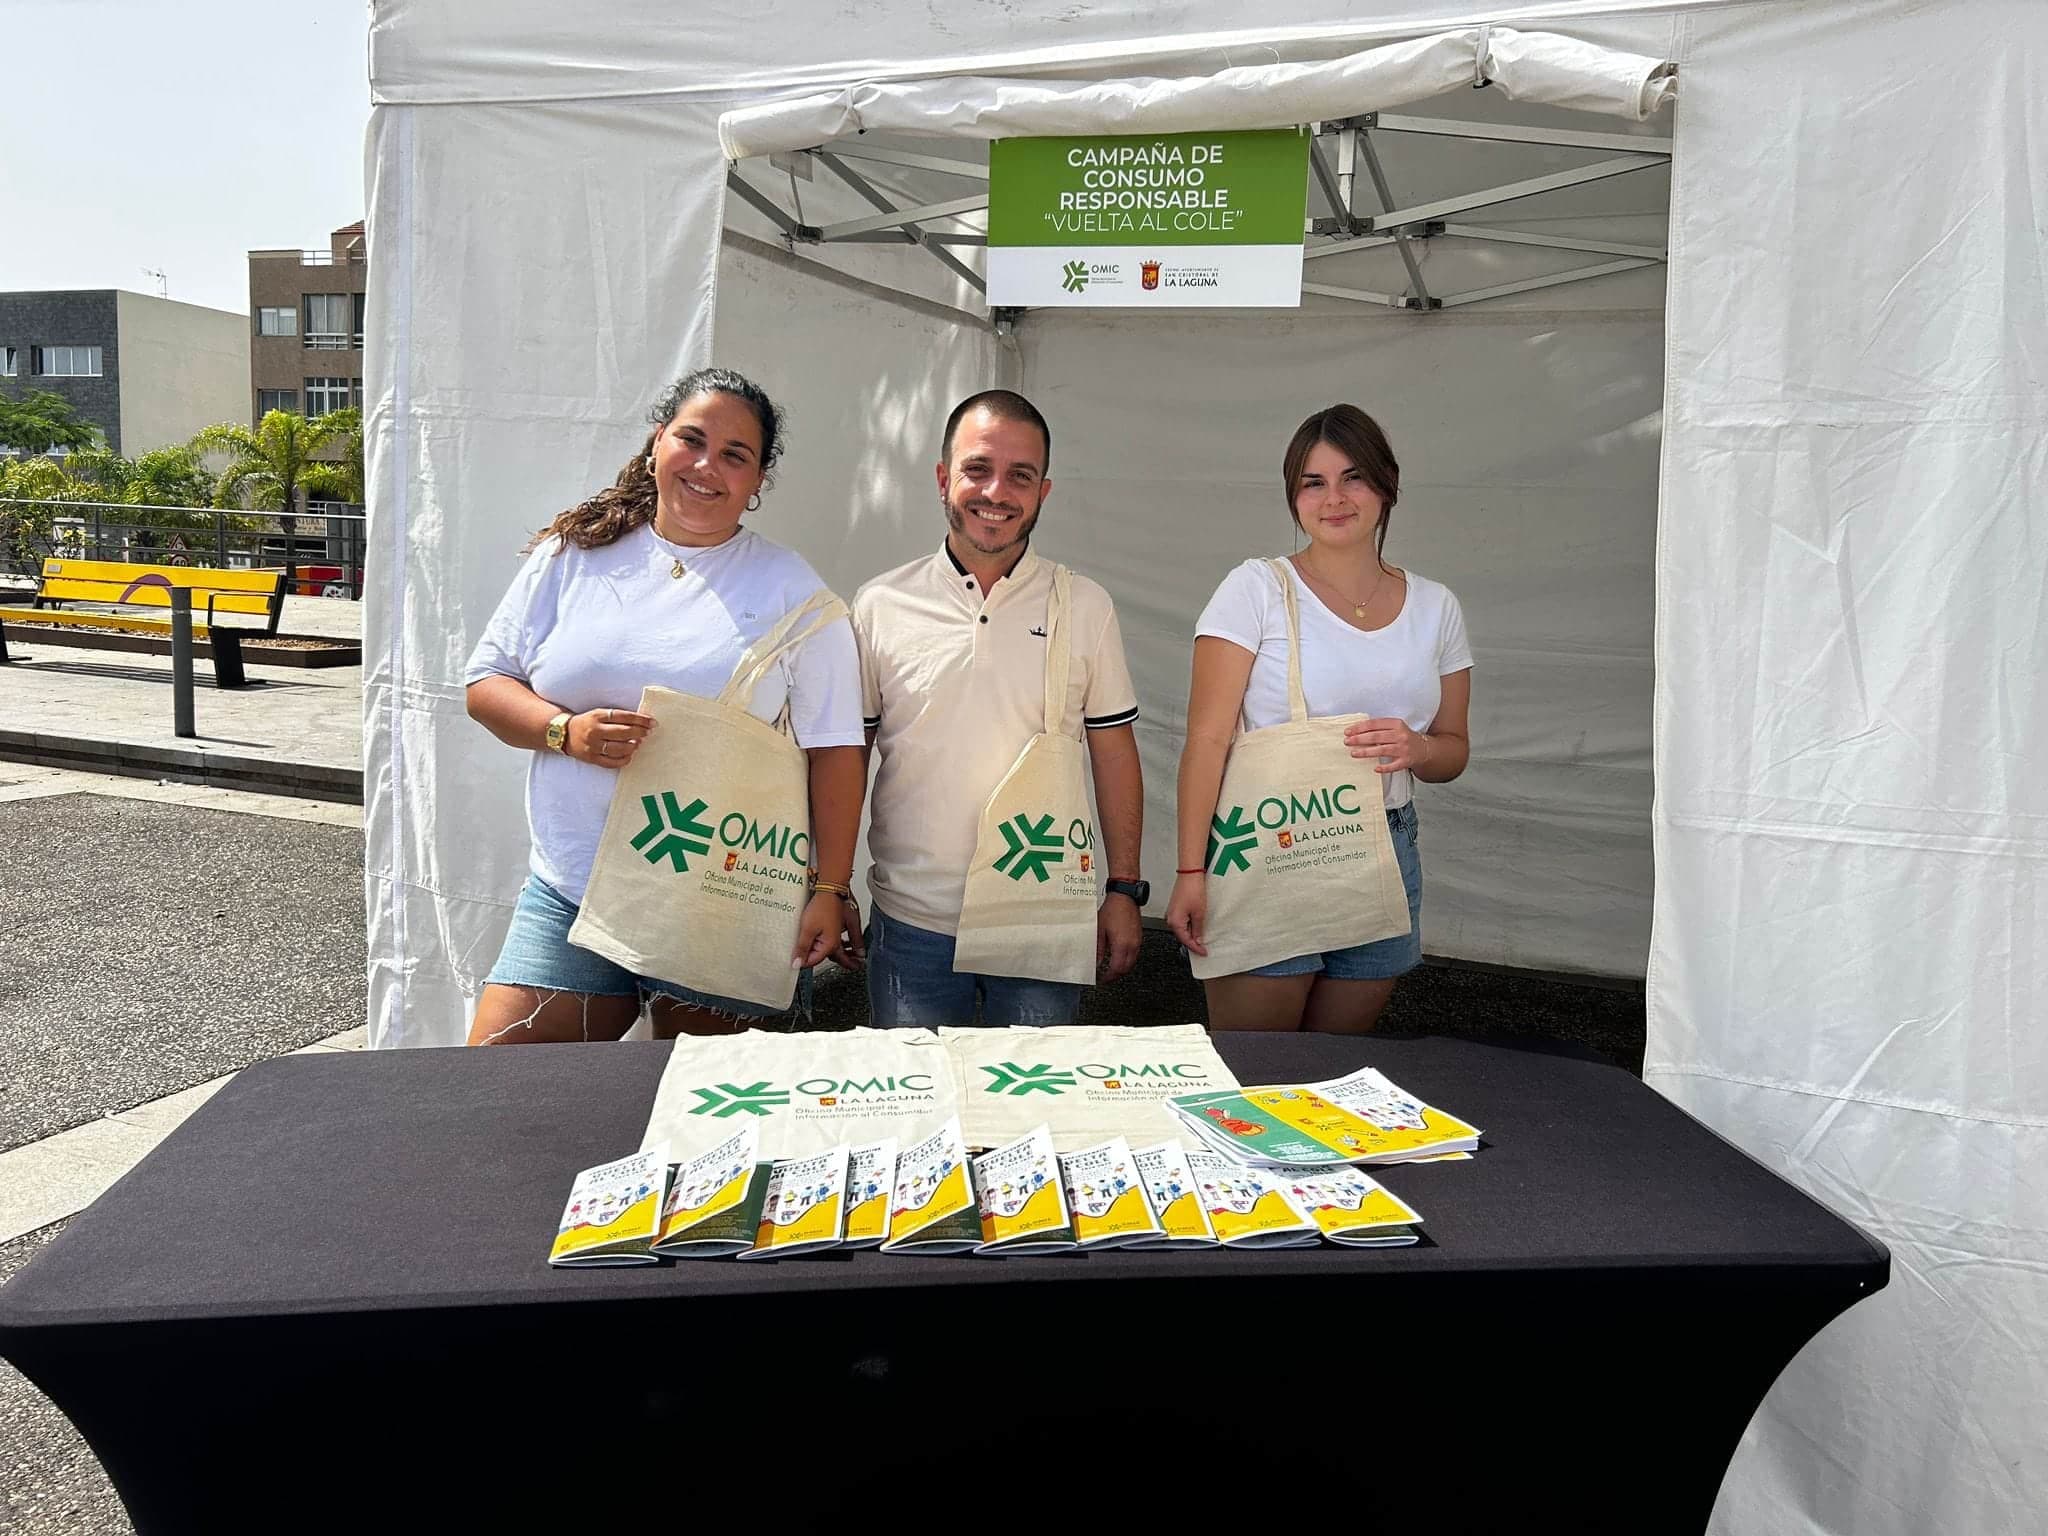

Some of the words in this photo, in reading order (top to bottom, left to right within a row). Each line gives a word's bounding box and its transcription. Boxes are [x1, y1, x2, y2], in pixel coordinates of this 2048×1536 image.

[1067, 142, 1184, 167] CAMPAÑA
[1191, 145, 1223, 164] DE
[1083, 168, 1204, 188] CONSUMO
[1060, 189, 1228, 210] RESPONSABLE
[1139, 212, 1168, 231] AL
[1091, 264, 1120, 274] OMIC
[1164, 278, 1176, 287] LA
[1178, 278, 1218, 287] LAGUNA
[1256, 784, 1361, 830] OMIC
[719, 812, 809, 867] OMIC
[1294, 832, 1310, 843] LA
[1312, 823, 1364, 840] LAGUNA
[1265, 853, 1292, 865] Oficina
[1293, 844, 1330, 859] Municipal
[1331, 843, 1341, 852] de
[1321, 851, 1367, 865] Consumidor
[704, 870, 727, 884] Oficina
[727, 876, 762, 893] Municipal
[763, 885, 774, 895] de
[735, 861, 749, 872] LA
[752, 864, 804, 886] LAGUNA
[748, 894, 796, 913] Consumidor
[1075, 1063, 1208, 1079] OMIC
[795, 1074, 934, 1095] OMIC
[865, 1094, 934, 1103] LAGUNA
